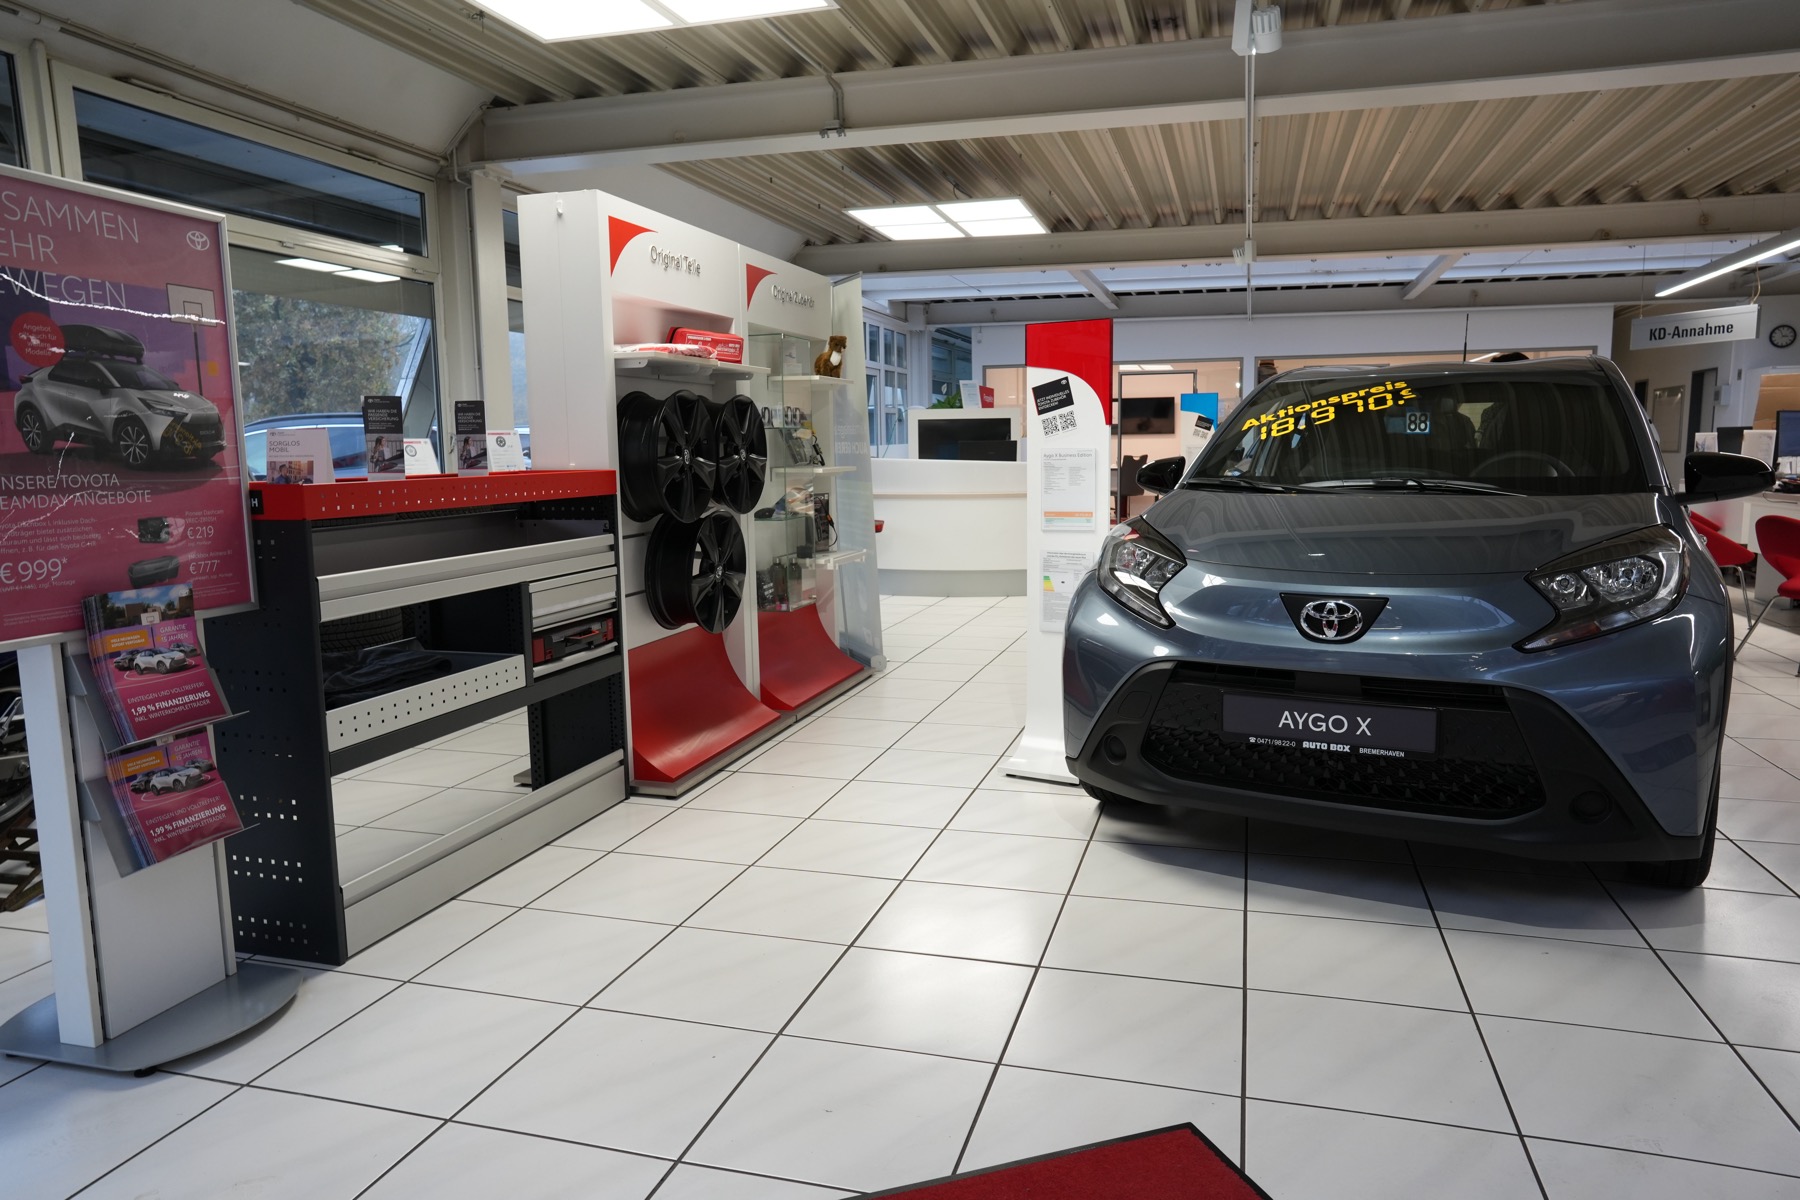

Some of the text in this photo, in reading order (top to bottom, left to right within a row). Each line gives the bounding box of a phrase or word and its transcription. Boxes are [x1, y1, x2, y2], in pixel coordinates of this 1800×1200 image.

[1, 191, 139, 243] SAMMEN
[650, 245, 701, 275] Original Teile
[23, 323, 51, 332] Angebot
[1649, 323, 1734, 341] KD-Annahme
[25, 347, 52, 356] Modelle
[1241, 381, 1407, 431] Aktionspreis
[1408, 413, 1428, 432] 88
[0, 473, 120, 490] NSERE TOYOTA
[73, 490, 152, 507] ANGEBOTE
[36, 528, 55, 536] bietet
[57, 525, 93, 534] zusätzlichen
[53, 518, 79, 526] inklusive
[43, 535, 58, 543] lässt
[60, 534, 72, 542] sich
[187, 525, 214, 539] € 219
[46, 543, 59, 551] den
[60, 541, 80, 550] Toyota
[0, 562, 15, 584] €
[189, 562, 197, 574] €
[168, 632, 189, 642] JAHREN
[127, 692, 158, 704] EINSTEIGEN
[170, 681, 205, 694] VOLLTREFFER!
[131, 690, 211, 716] 1,99 % FINANZIERUNG
[148, 699, 211, 720] WINTERKOMPLETTRÄDER
[1278, 710, 1372, 736] AYGO X
[182, 748, 203, 759] JAHREN
[1302, 741, 1328, 751] AUTO
[1330, 743, 1351, 753] BOX
[1359, 747, 1405, 758] BREMERHAVEN
[145, 795, 221, 826] EINSTEIGEN UND VOLLTREFFER!
[150, 804, 227, 837] 1,99 % FINANZIERUNG
[166, 813, 227, 839] WINTERKOMPLETTRÄDER
